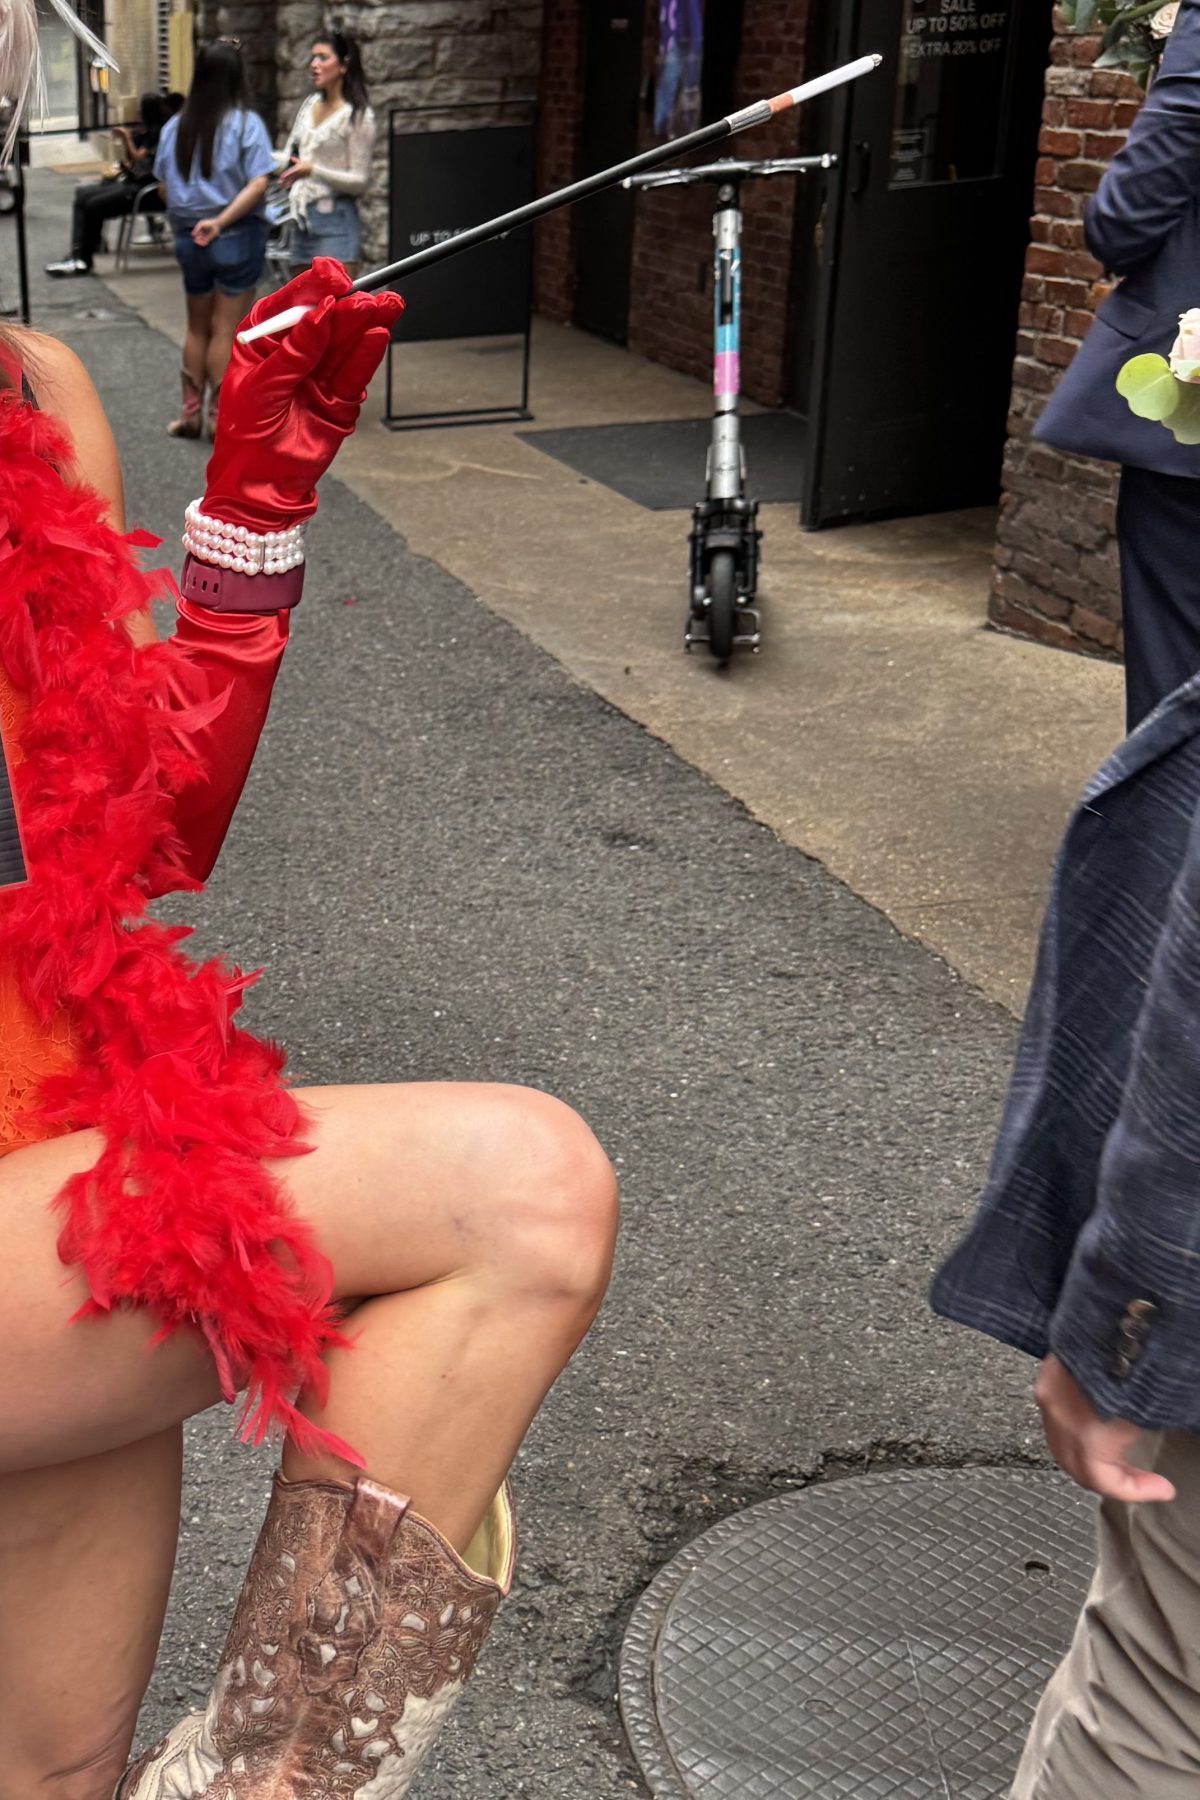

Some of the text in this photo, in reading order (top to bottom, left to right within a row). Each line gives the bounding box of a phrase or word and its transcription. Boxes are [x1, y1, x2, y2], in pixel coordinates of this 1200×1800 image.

[940, 0, 976, 14] SALE
[906, 18, 927, 34] UP
[928, 16, 948, 32] TO
[980, 12, 1007, 29] OFF
[909, 41, 950, 58] EXTRA
[410, 230, 431, 246] UP
